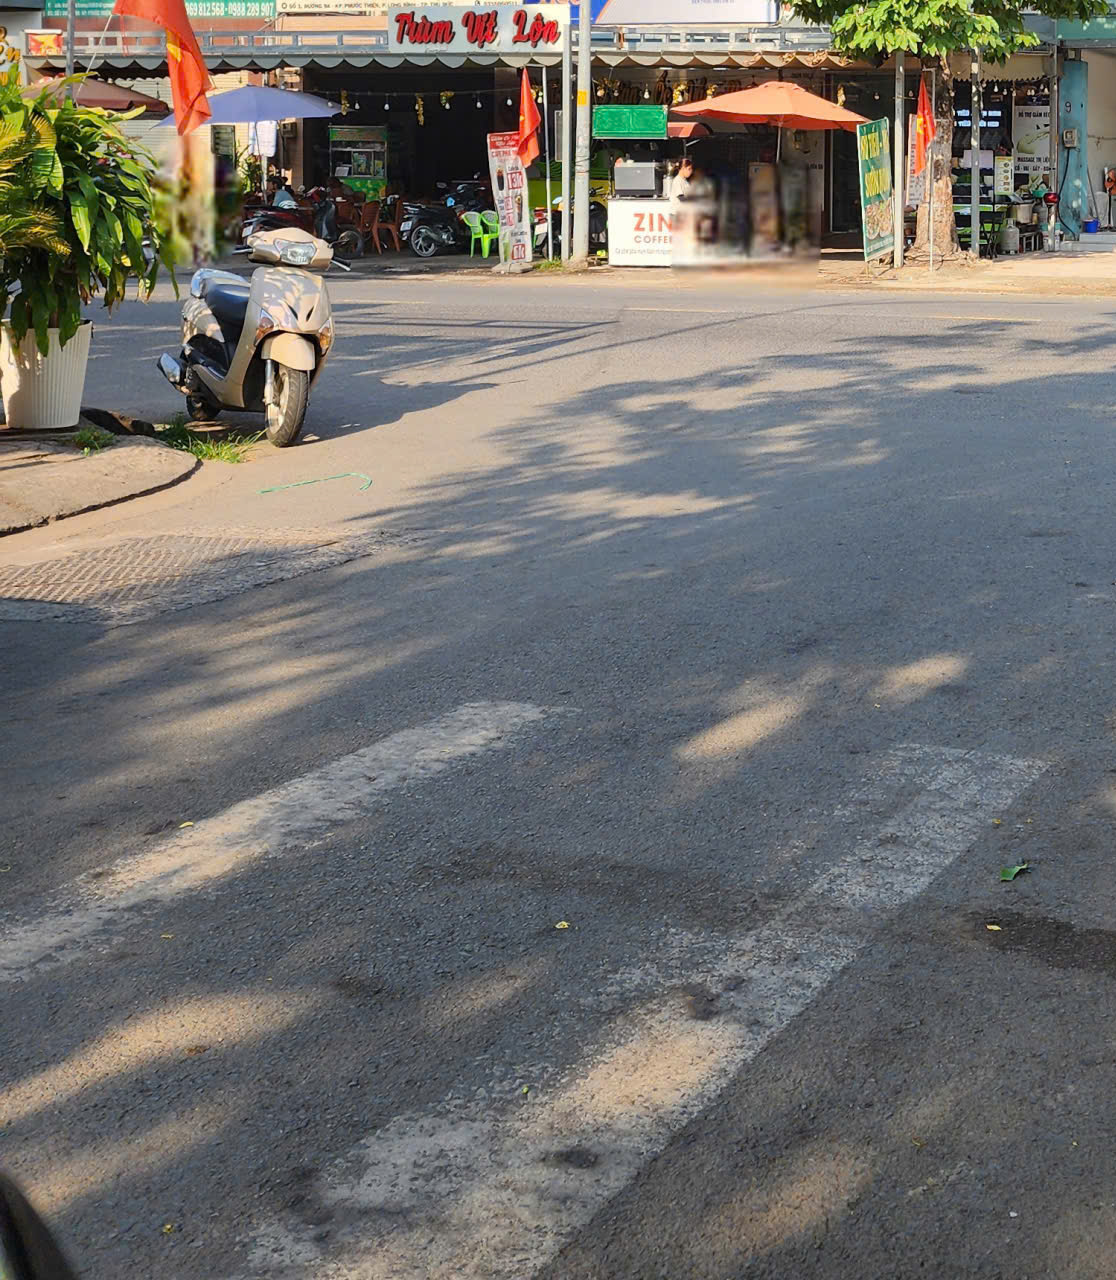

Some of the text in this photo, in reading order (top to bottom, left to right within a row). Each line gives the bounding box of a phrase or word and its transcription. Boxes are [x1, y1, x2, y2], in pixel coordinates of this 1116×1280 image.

[395, 9, 561, 48] Trùm Vịt Lộn
[1065, 101, 1072, 112] 9
